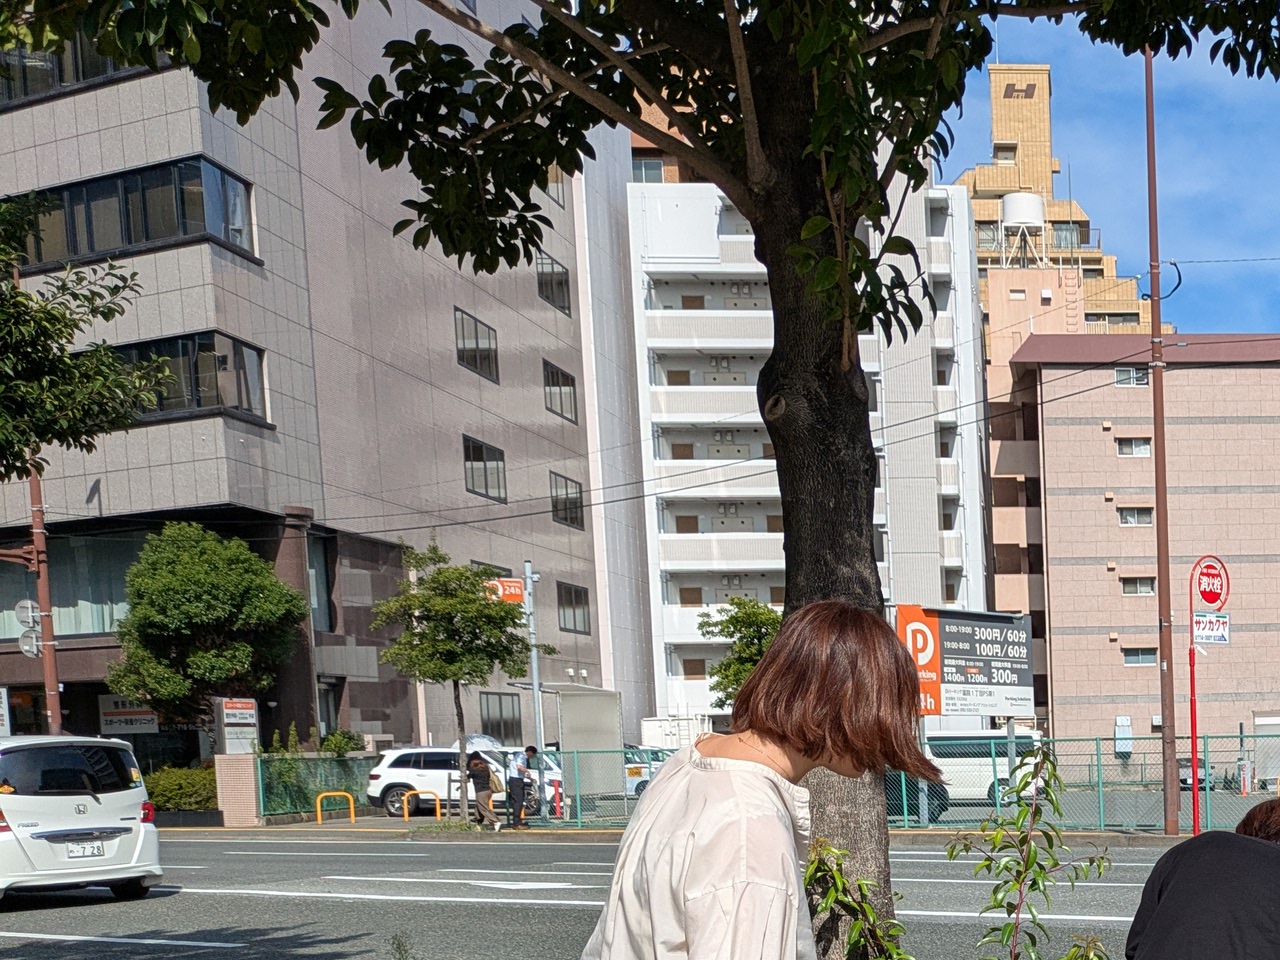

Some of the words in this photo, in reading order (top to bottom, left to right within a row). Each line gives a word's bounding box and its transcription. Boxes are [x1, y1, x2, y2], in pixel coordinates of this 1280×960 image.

[504, 586, 521, 595] 24h
[1200, 576, 1222, 593] 消火栓
[1195, 619, 1228, 632] サンカクヤ
[945, 625, 972, 634] 8:00-19:00
[974, 627, 1027, 643] 300円/60分
[944, 641, 970, 650] 19:00-8:00
[975, 643, 1028, 658] 100円/60分
[944, 673, 965, 682] 1400円
[967, 673, 988, 683] 1200円
[991, 669, 1018, 684] 300円
